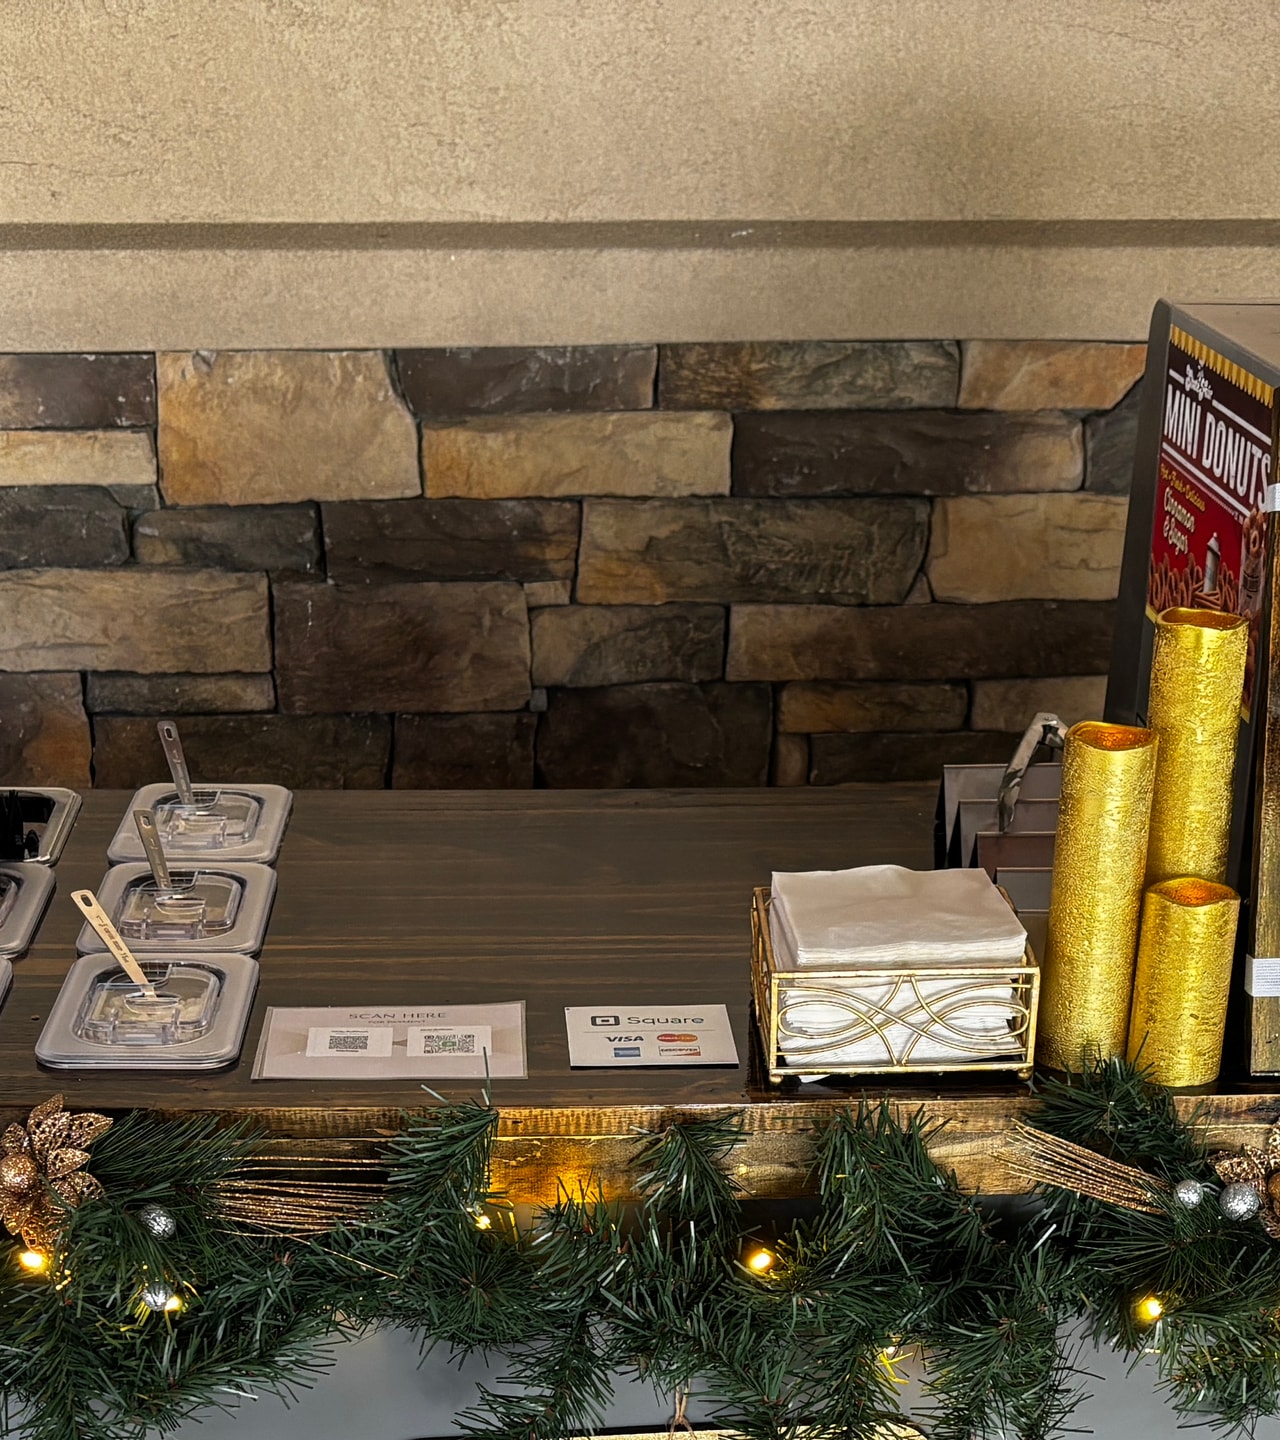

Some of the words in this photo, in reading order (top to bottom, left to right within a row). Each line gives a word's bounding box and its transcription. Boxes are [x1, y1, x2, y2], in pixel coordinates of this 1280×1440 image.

[1163, 384, 1201, 459] MINI
[1202, 411, 1271, 514] DONUTS
[627, 1016, 704, 1026] Square
